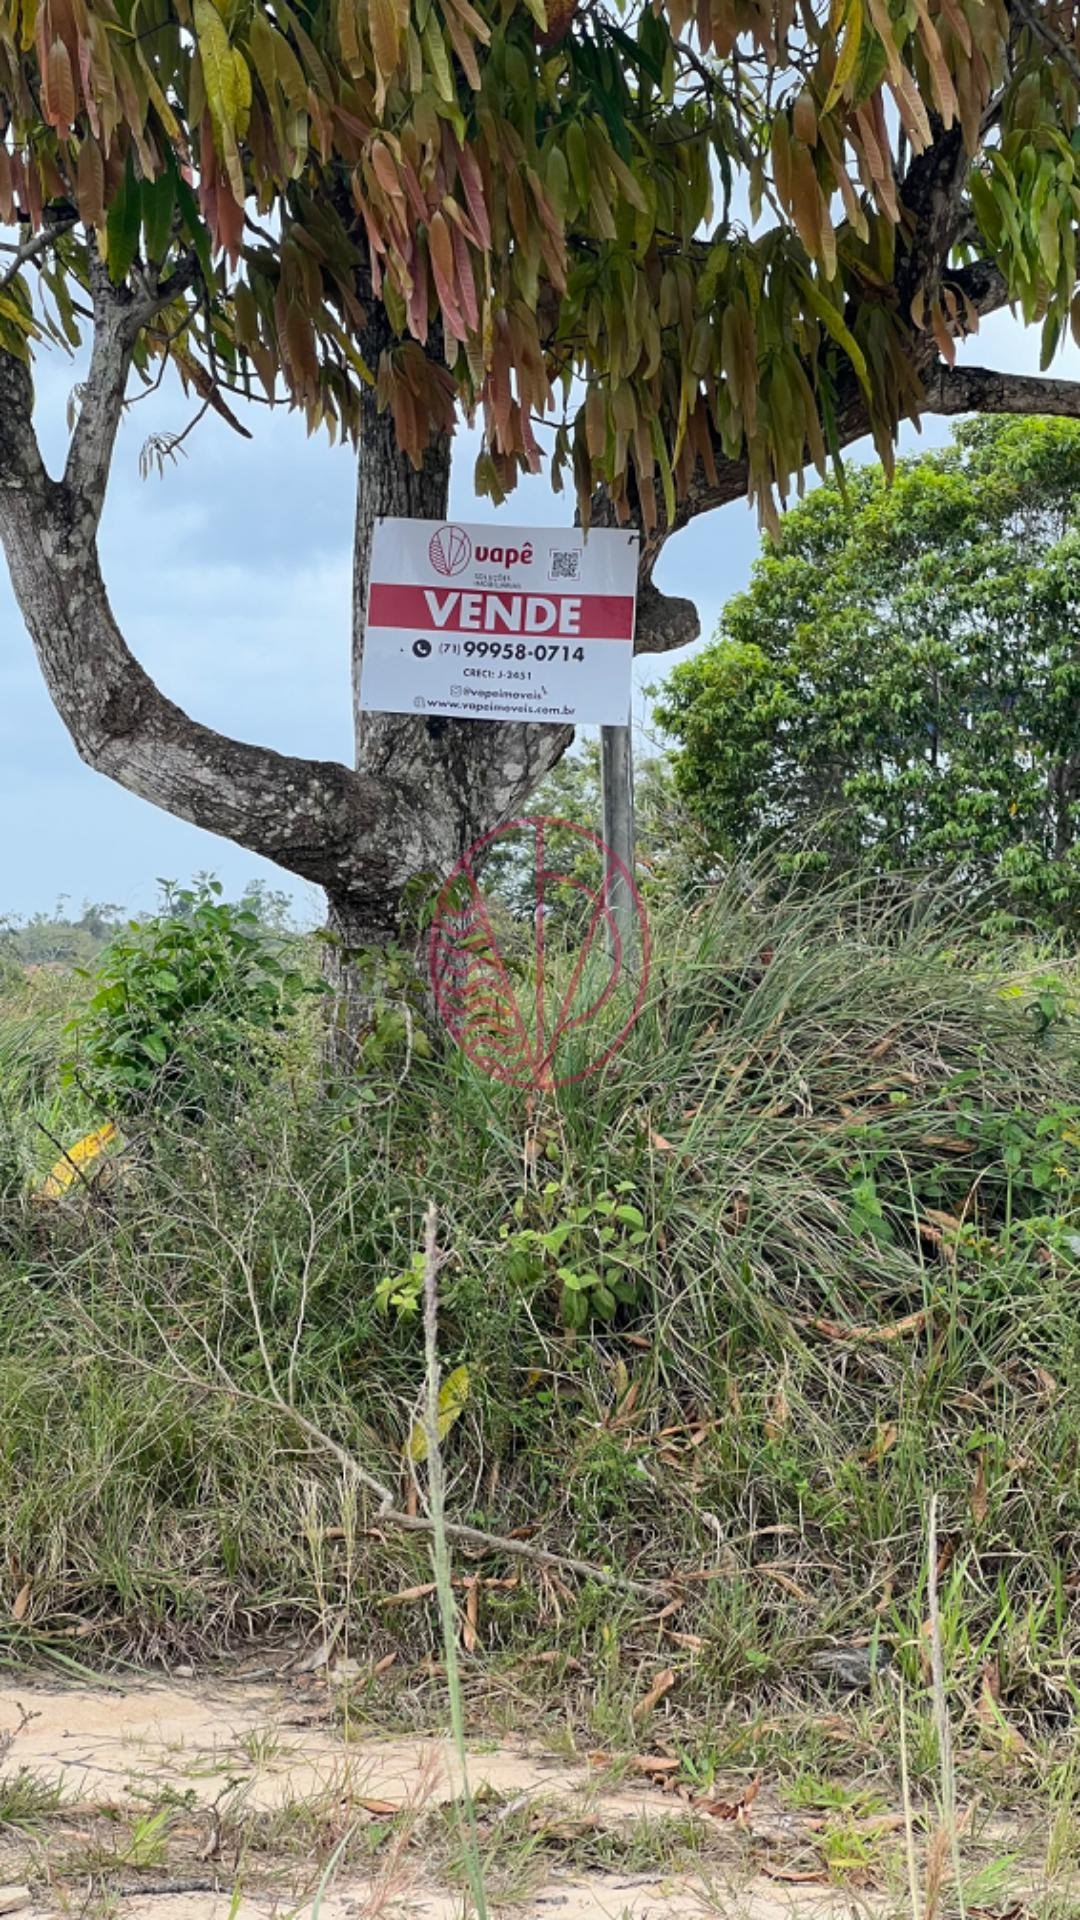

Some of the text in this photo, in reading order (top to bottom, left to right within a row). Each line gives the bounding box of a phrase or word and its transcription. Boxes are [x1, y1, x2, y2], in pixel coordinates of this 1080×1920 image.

[475, 542, 533, 569] vapê
[423, 590, 582, 634] VENDE
[439, 641, 585, 662] (71) 99958-0714
[427, 700, 576, 716] www.vapeimoveis.com.br
